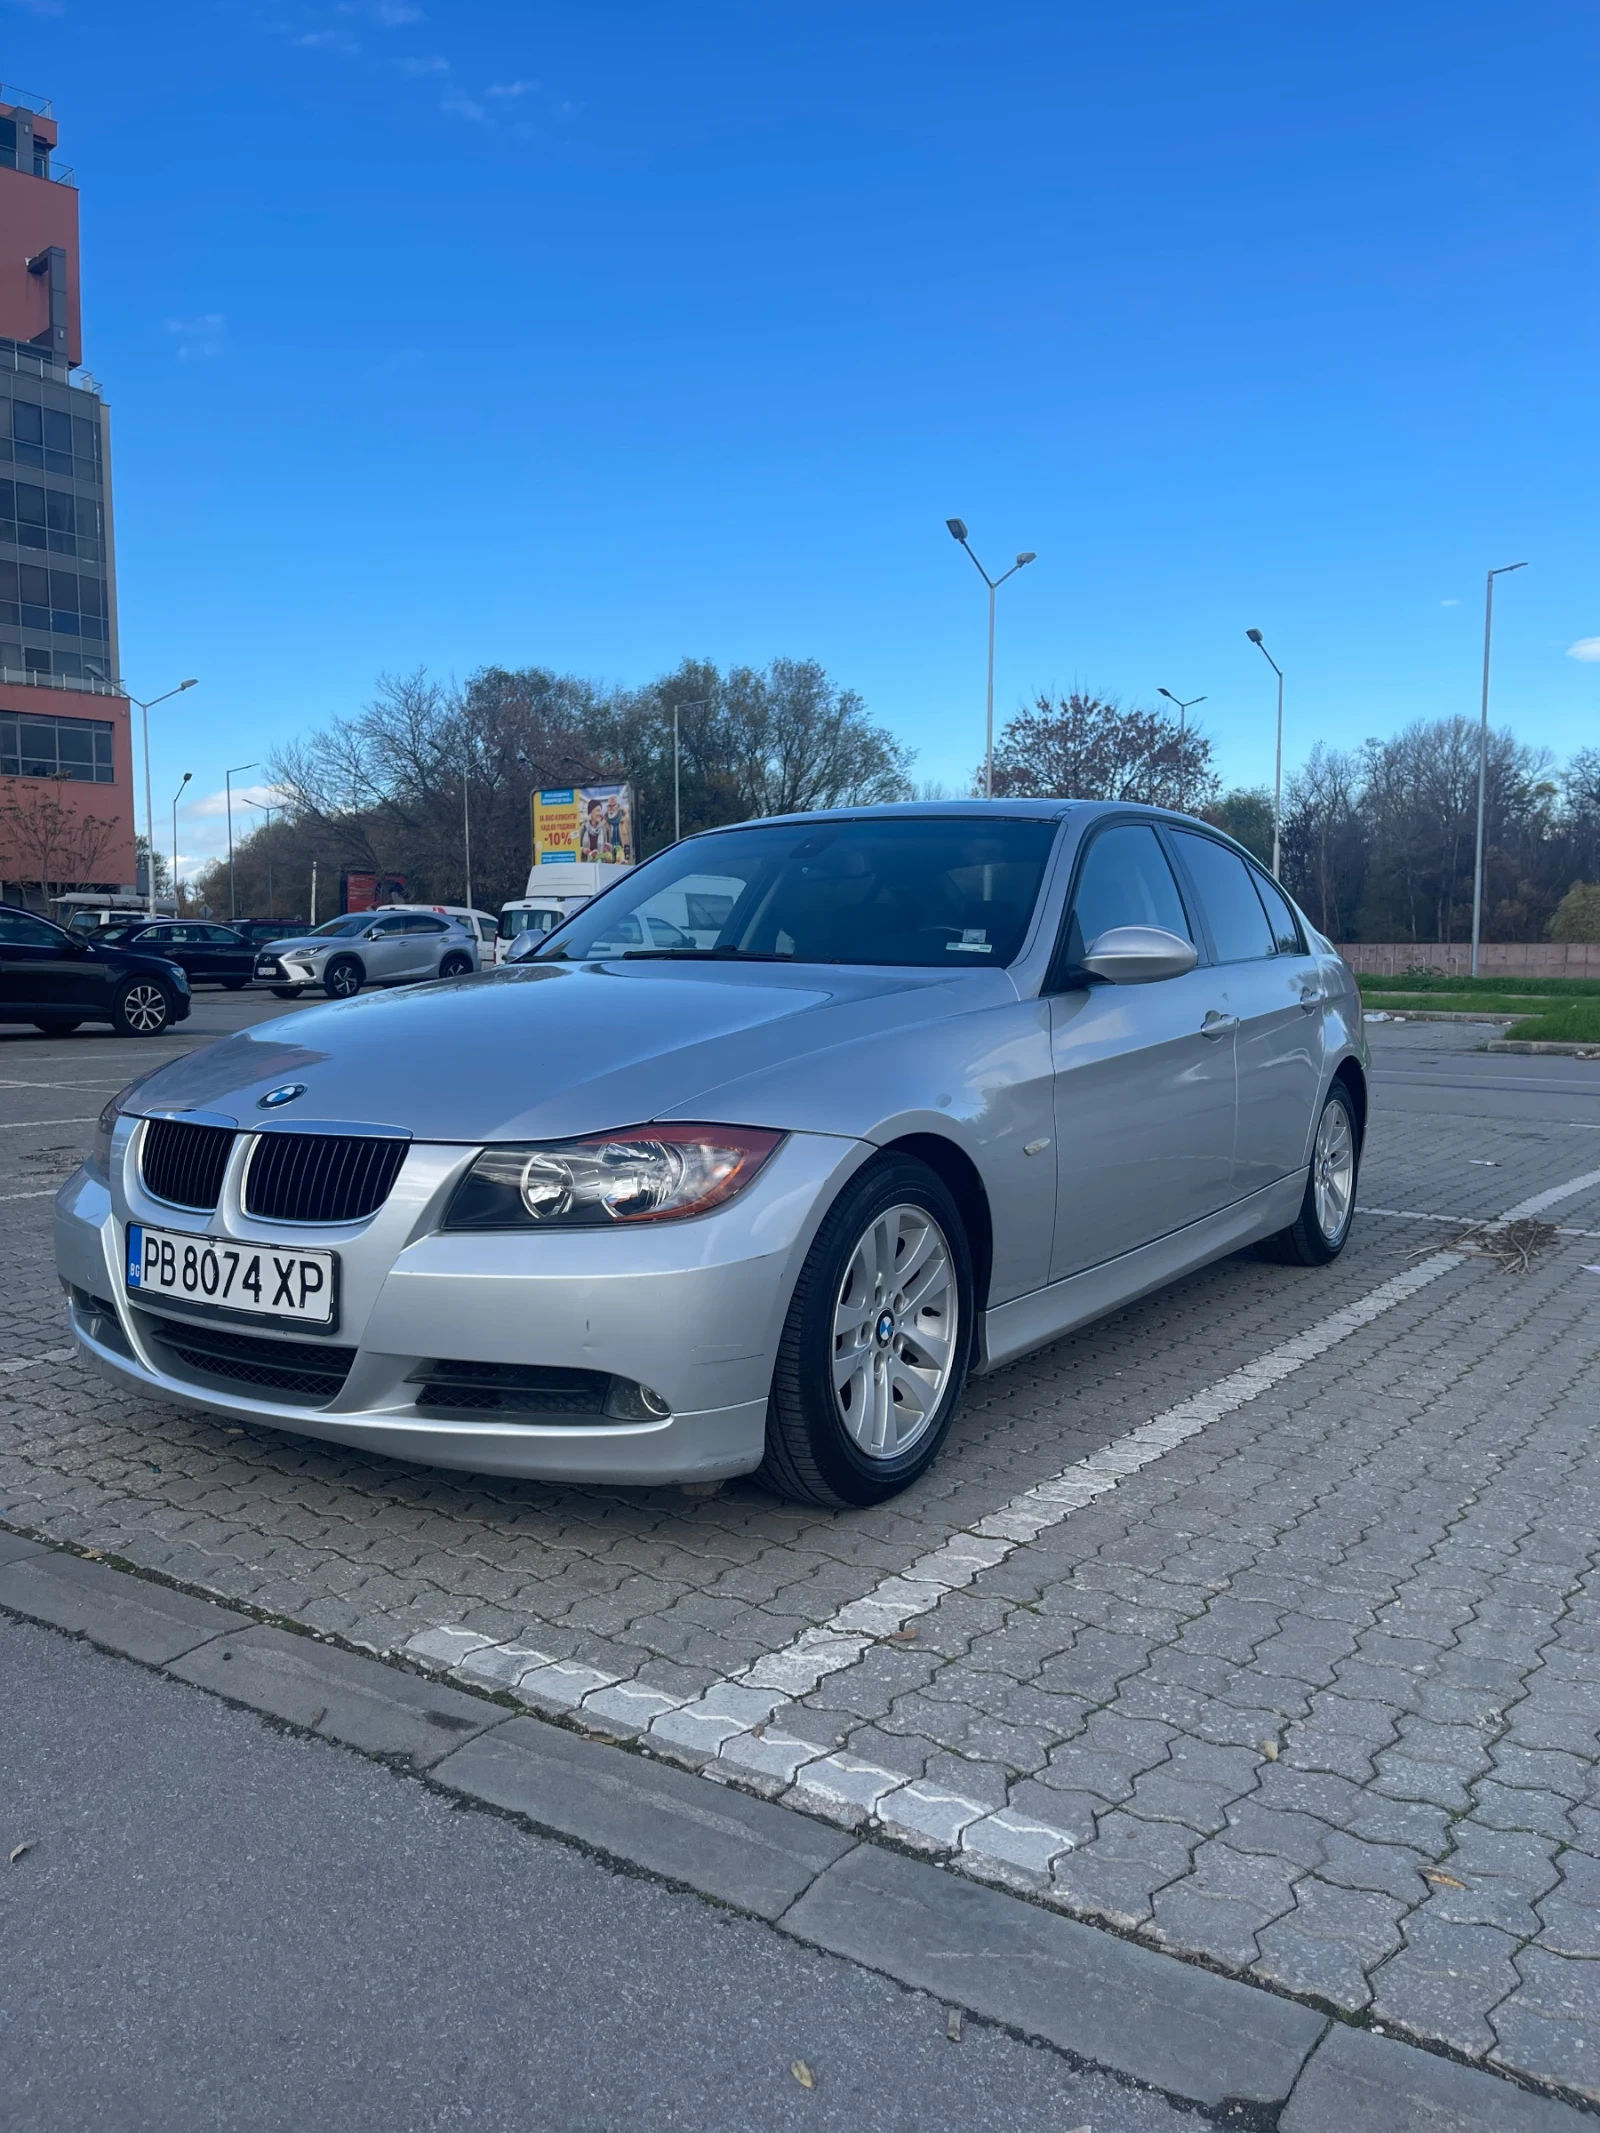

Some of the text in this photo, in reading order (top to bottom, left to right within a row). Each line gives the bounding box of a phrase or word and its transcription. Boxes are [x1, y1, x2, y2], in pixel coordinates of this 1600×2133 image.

[544, 831, 572, 846] -10%
[130, 1262, 141, 1278] BG
[143, 1236, 324, 1309] PB 8074 XP
